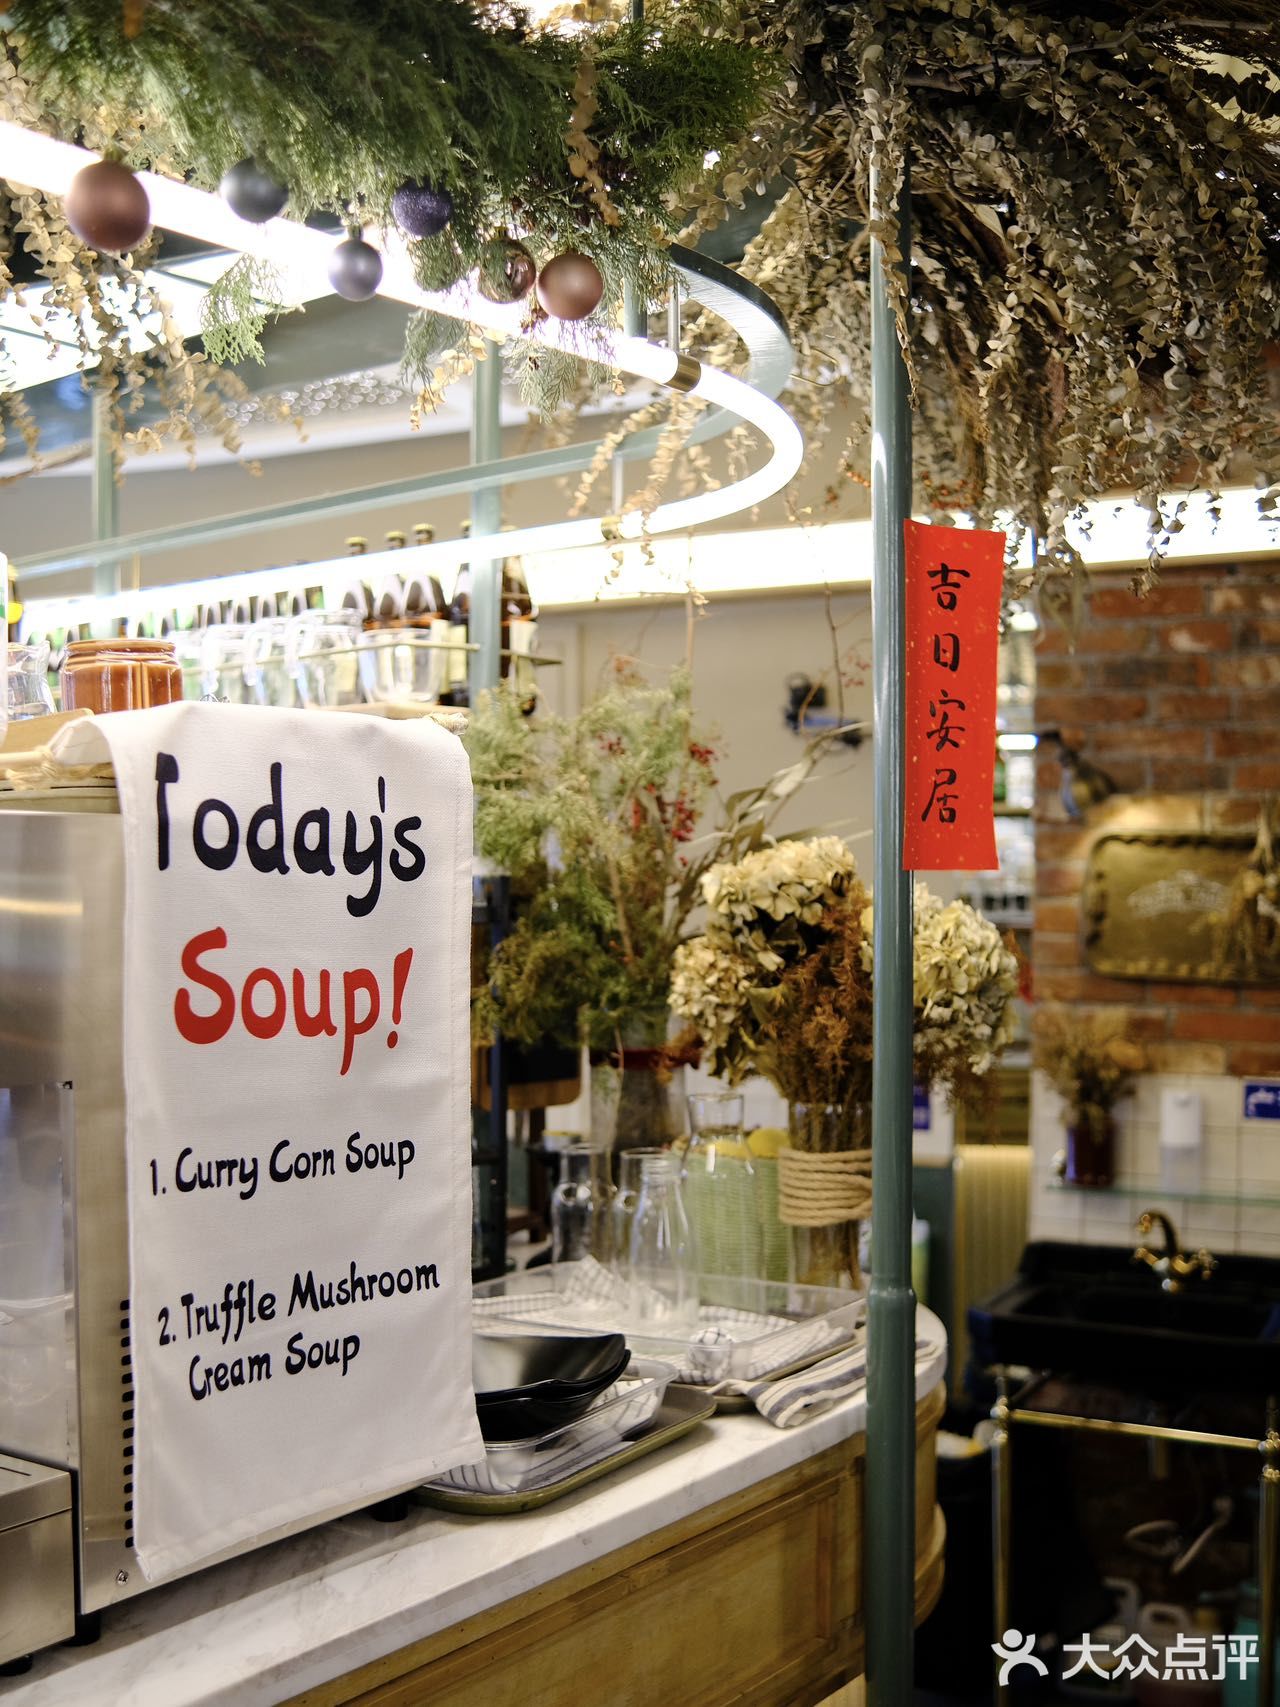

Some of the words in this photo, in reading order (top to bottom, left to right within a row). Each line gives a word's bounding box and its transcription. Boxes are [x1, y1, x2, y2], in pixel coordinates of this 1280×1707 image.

[921, 562, 970, 824] 吉日安居
[155, 752, 426, 917] Today's
[174, 926, 414, 1076] Soup!
[149, 1158, 167, 1195] 1.
[174, 1147, 259, 1200] Curry
[268, 1139, 336, 1182] Corn
[345, 1131, 416, 1179] Soup
[157, 1307, 177, 1346] 2.
[180, 1279, 277, 1344] Truffle
[287, 1260, 441, 1316] Mushroom
[188, 1352, 272, 1401] Cream
[285, 1331, 360, 1376] Soup
